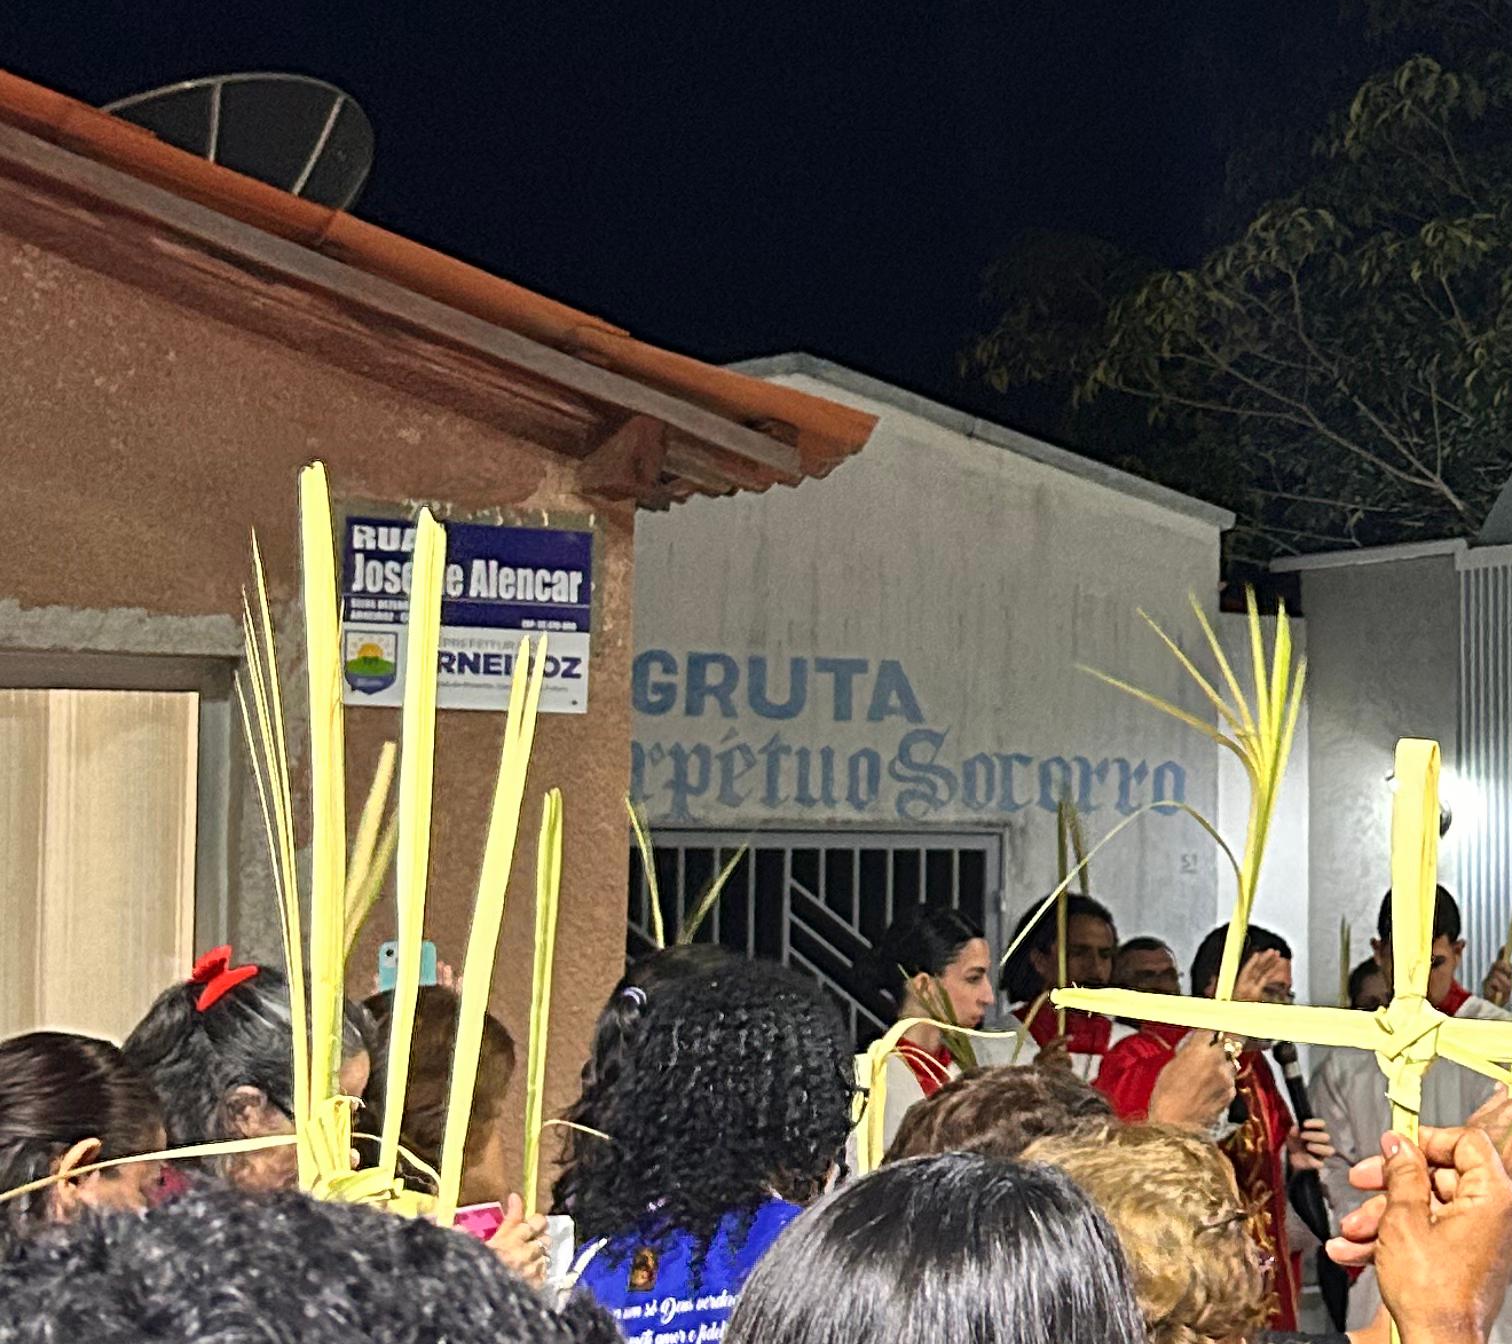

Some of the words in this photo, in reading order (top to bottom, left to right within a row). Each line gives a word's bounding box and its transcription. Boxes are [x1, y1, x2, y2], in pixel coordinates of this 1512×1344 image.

[445, 563, 464, 597] e
[469, 559, 583, 603] Alencar
[438, 650, 582, 679] RNEIOZ
[632, 648, 925, 724] GRUTA
[631, 726, 880, 821] rpétuo
[888, 726, 1186, 821] Socorro
